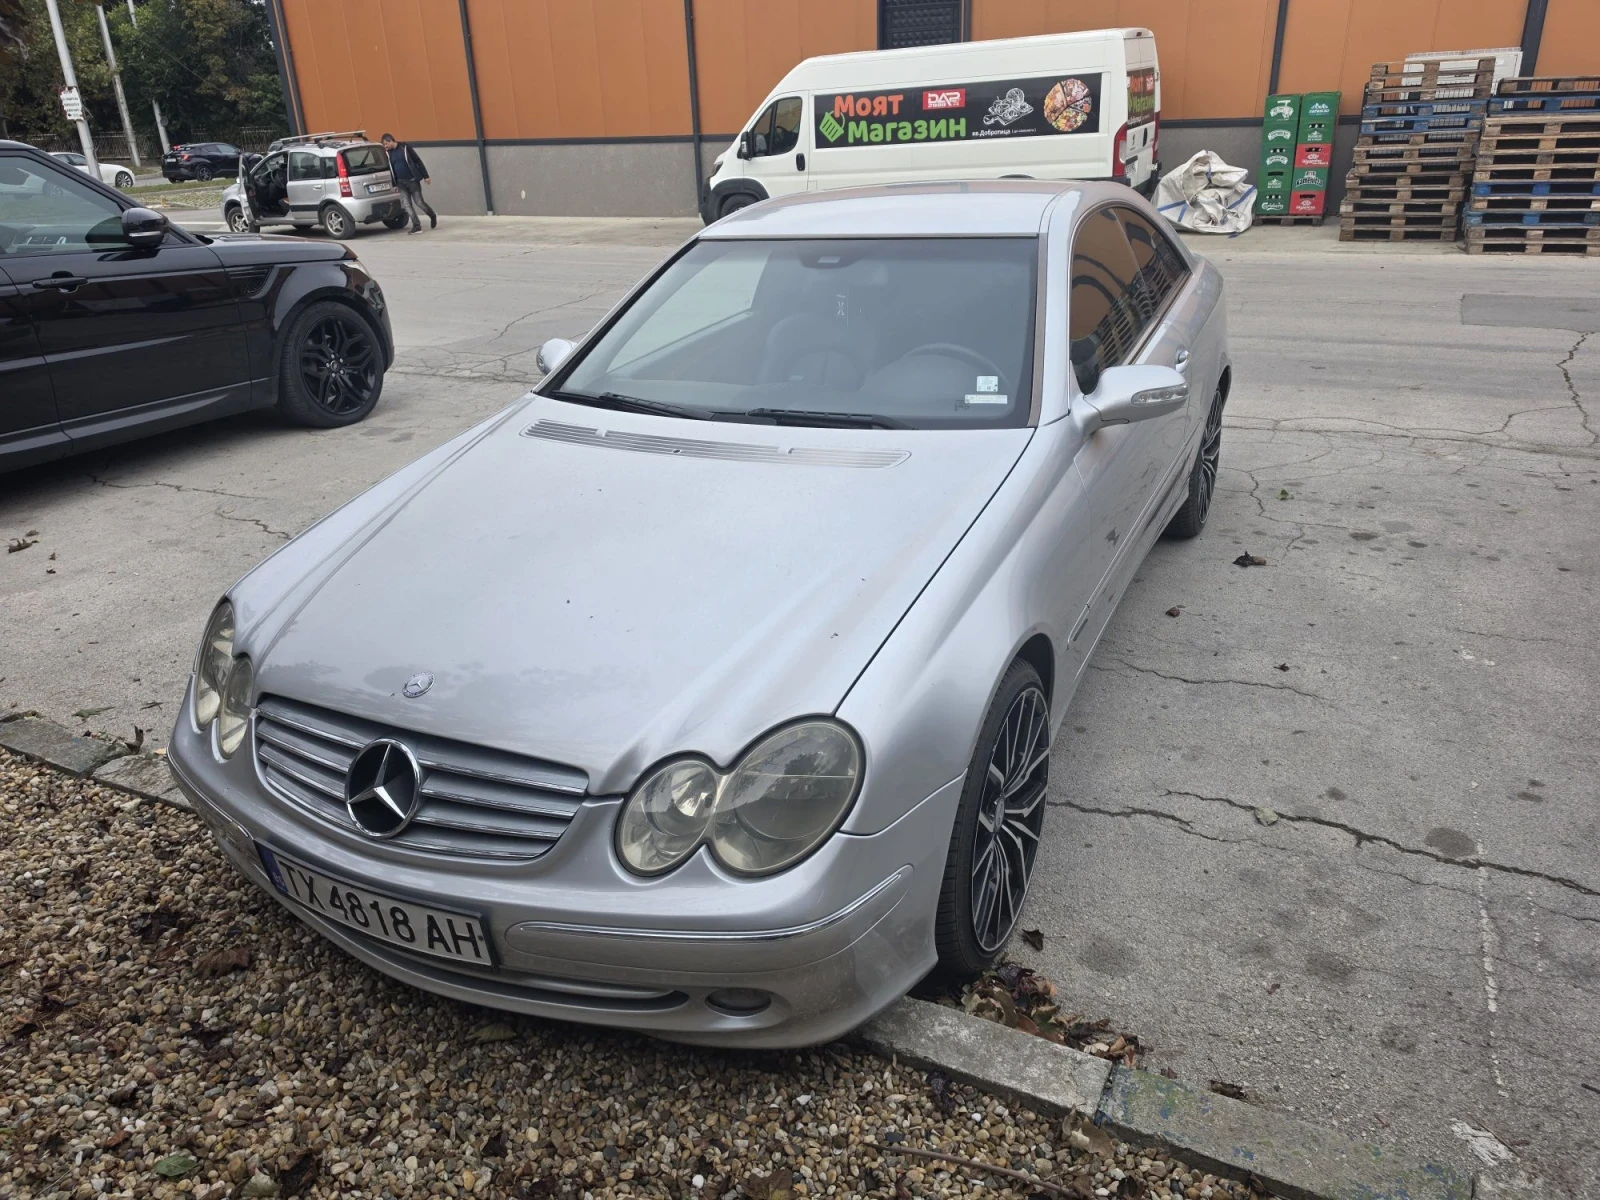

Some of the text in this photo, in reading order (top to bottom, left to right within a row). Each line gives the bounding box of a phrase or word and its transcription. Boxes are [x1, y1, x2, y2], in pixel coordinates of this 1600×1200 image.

[834, 95, 903, 118] Моят
[848, 118, 966, 143] Магазин
[329, 885, 416, 943] 4818
[426, 914, 482, 958] AH
